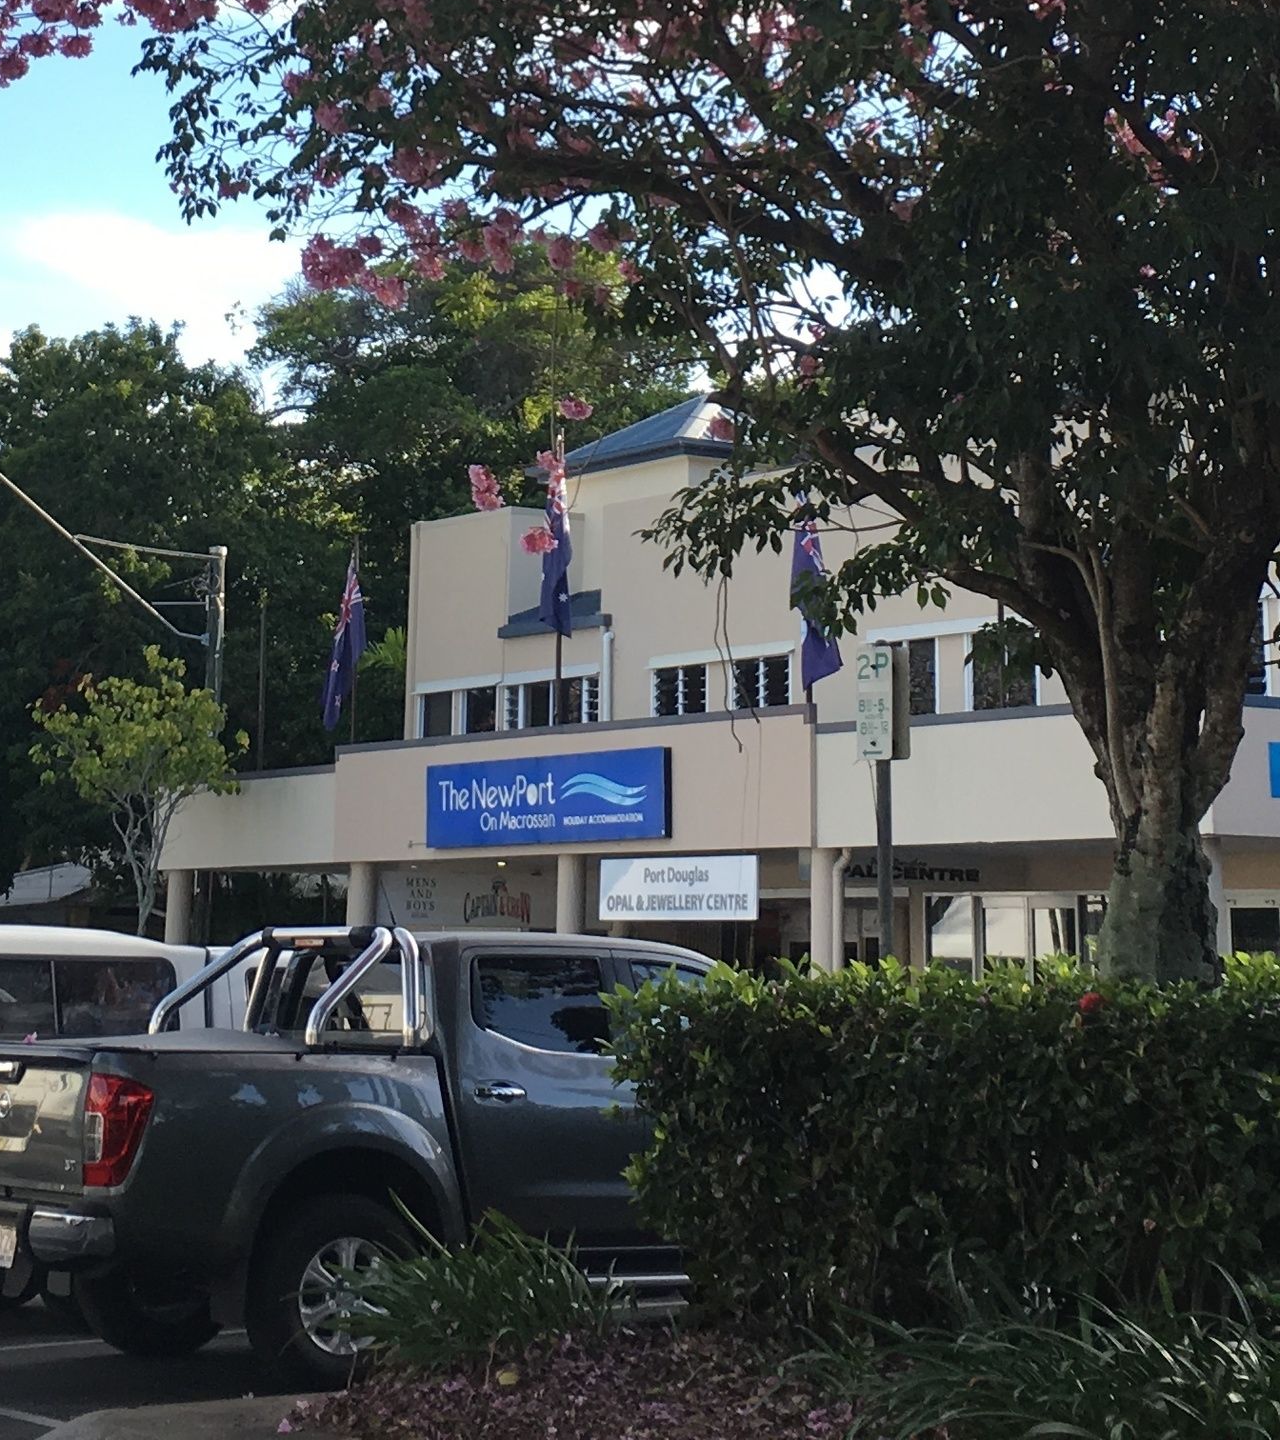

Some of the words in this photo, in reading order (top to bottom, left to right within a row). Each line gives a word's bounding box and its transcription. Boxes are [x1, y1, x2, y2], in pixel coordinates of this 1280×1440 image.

[856, 652, 889, 680] 2P
[438, 780, 470, 811] The
[472, 772, 556, 810] NewPort
[480, 813, 497, 832] On
[499, 810, 556, 830] Macrossan
[405, 877, 437, 888] MENS
[644, 867, 665, 884] Port
[667, 866, 709, 887] Douglas
[410, 888, 433, 899] AND
[606, 895, 634, 911] OPAL
[636, 894, 645, 910] &
[646, 894, 706, 911] JEWELLERY
[707, 893, 748, 910] CENTRE
[405, 900, 436, 911] BOYS
